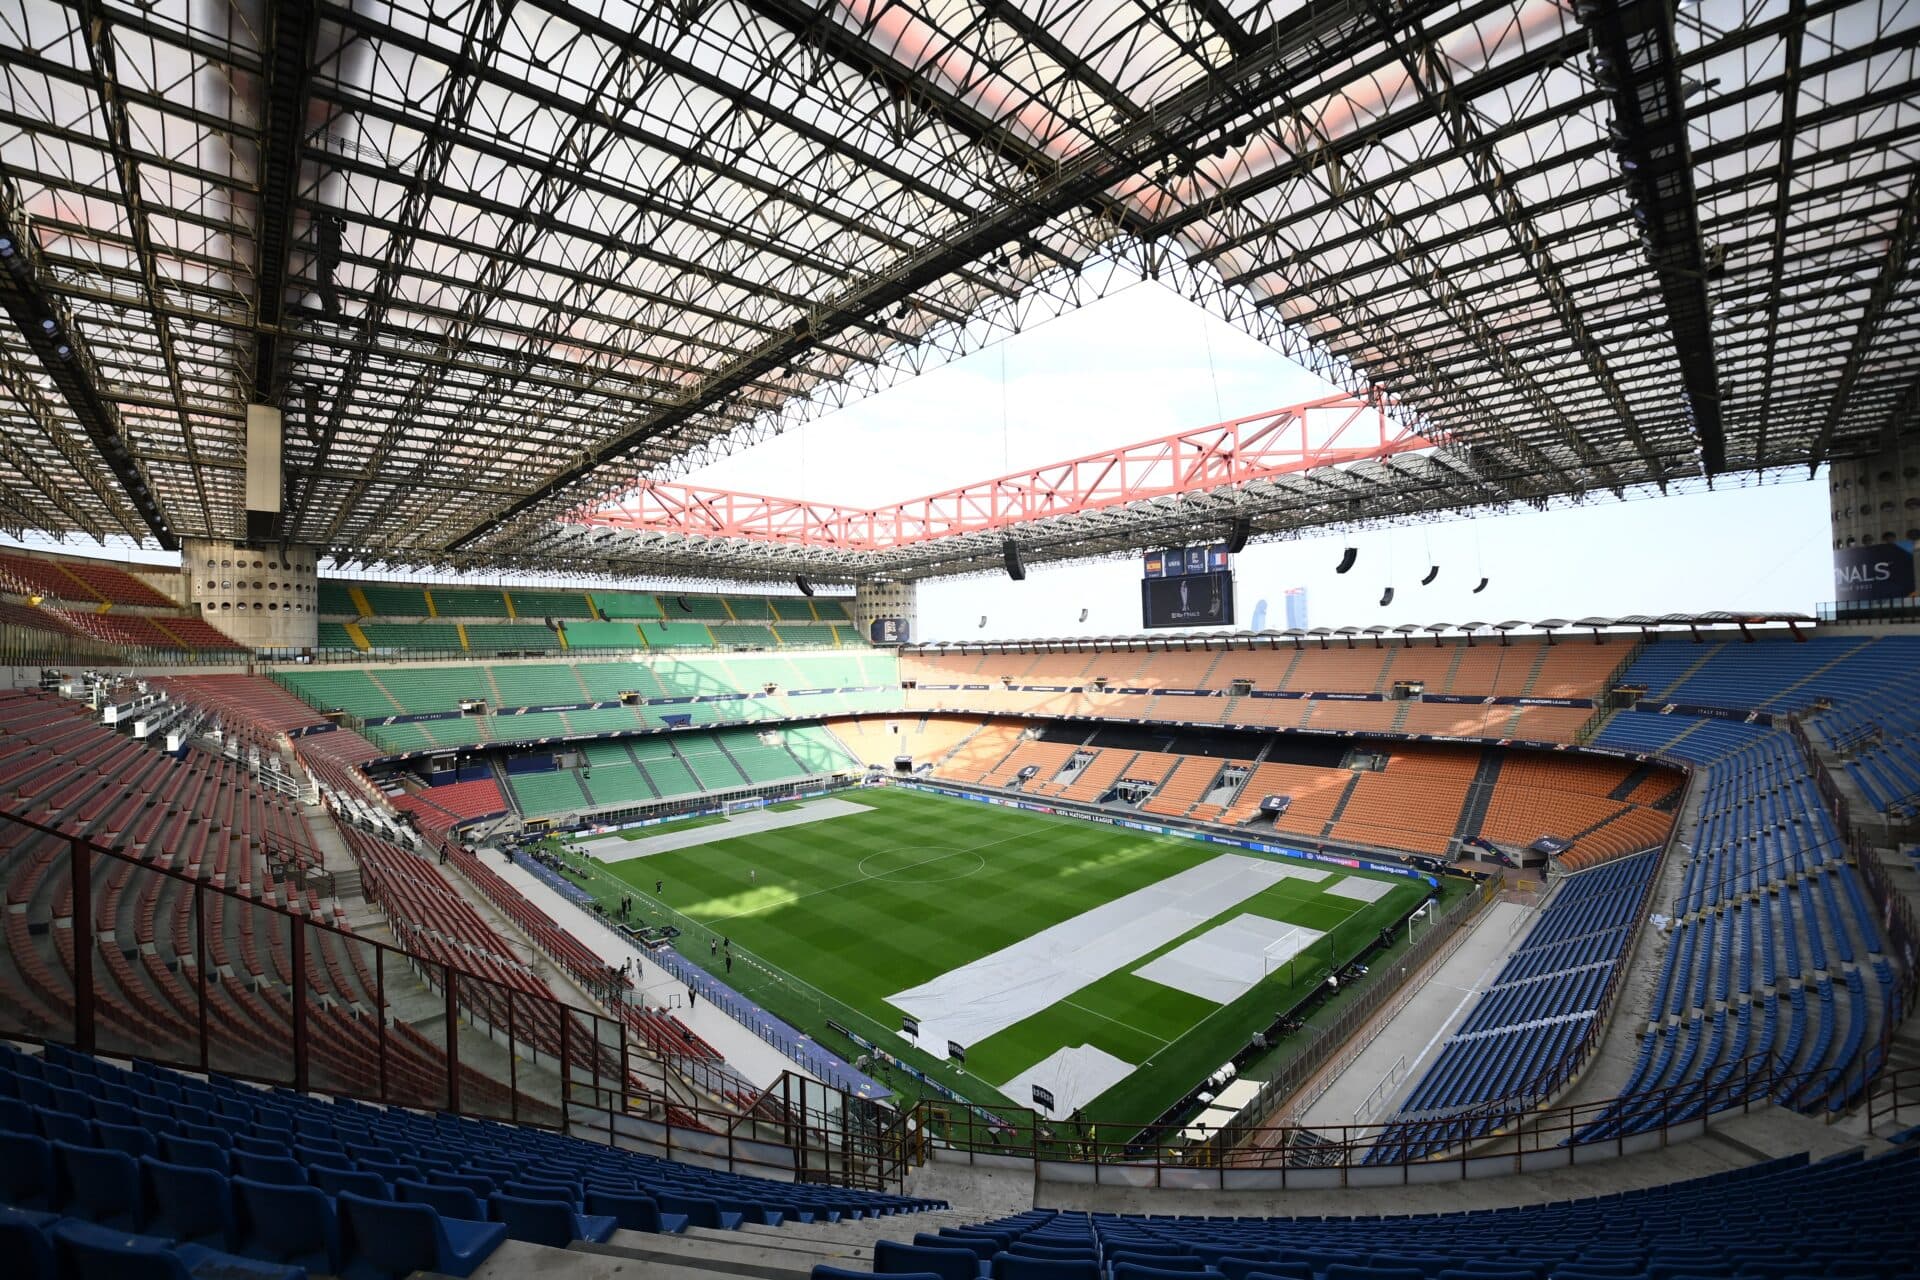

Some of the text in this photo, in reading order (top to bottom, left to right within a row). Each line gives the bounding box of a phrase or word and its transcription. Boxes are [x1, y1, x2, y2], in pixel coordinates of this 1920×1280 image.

[1068, 810, 1091, 820] NATIONS
[1092, 815, 1114, 824] LEAGUE
[1370, 863, 1409, 876] Booking.com
